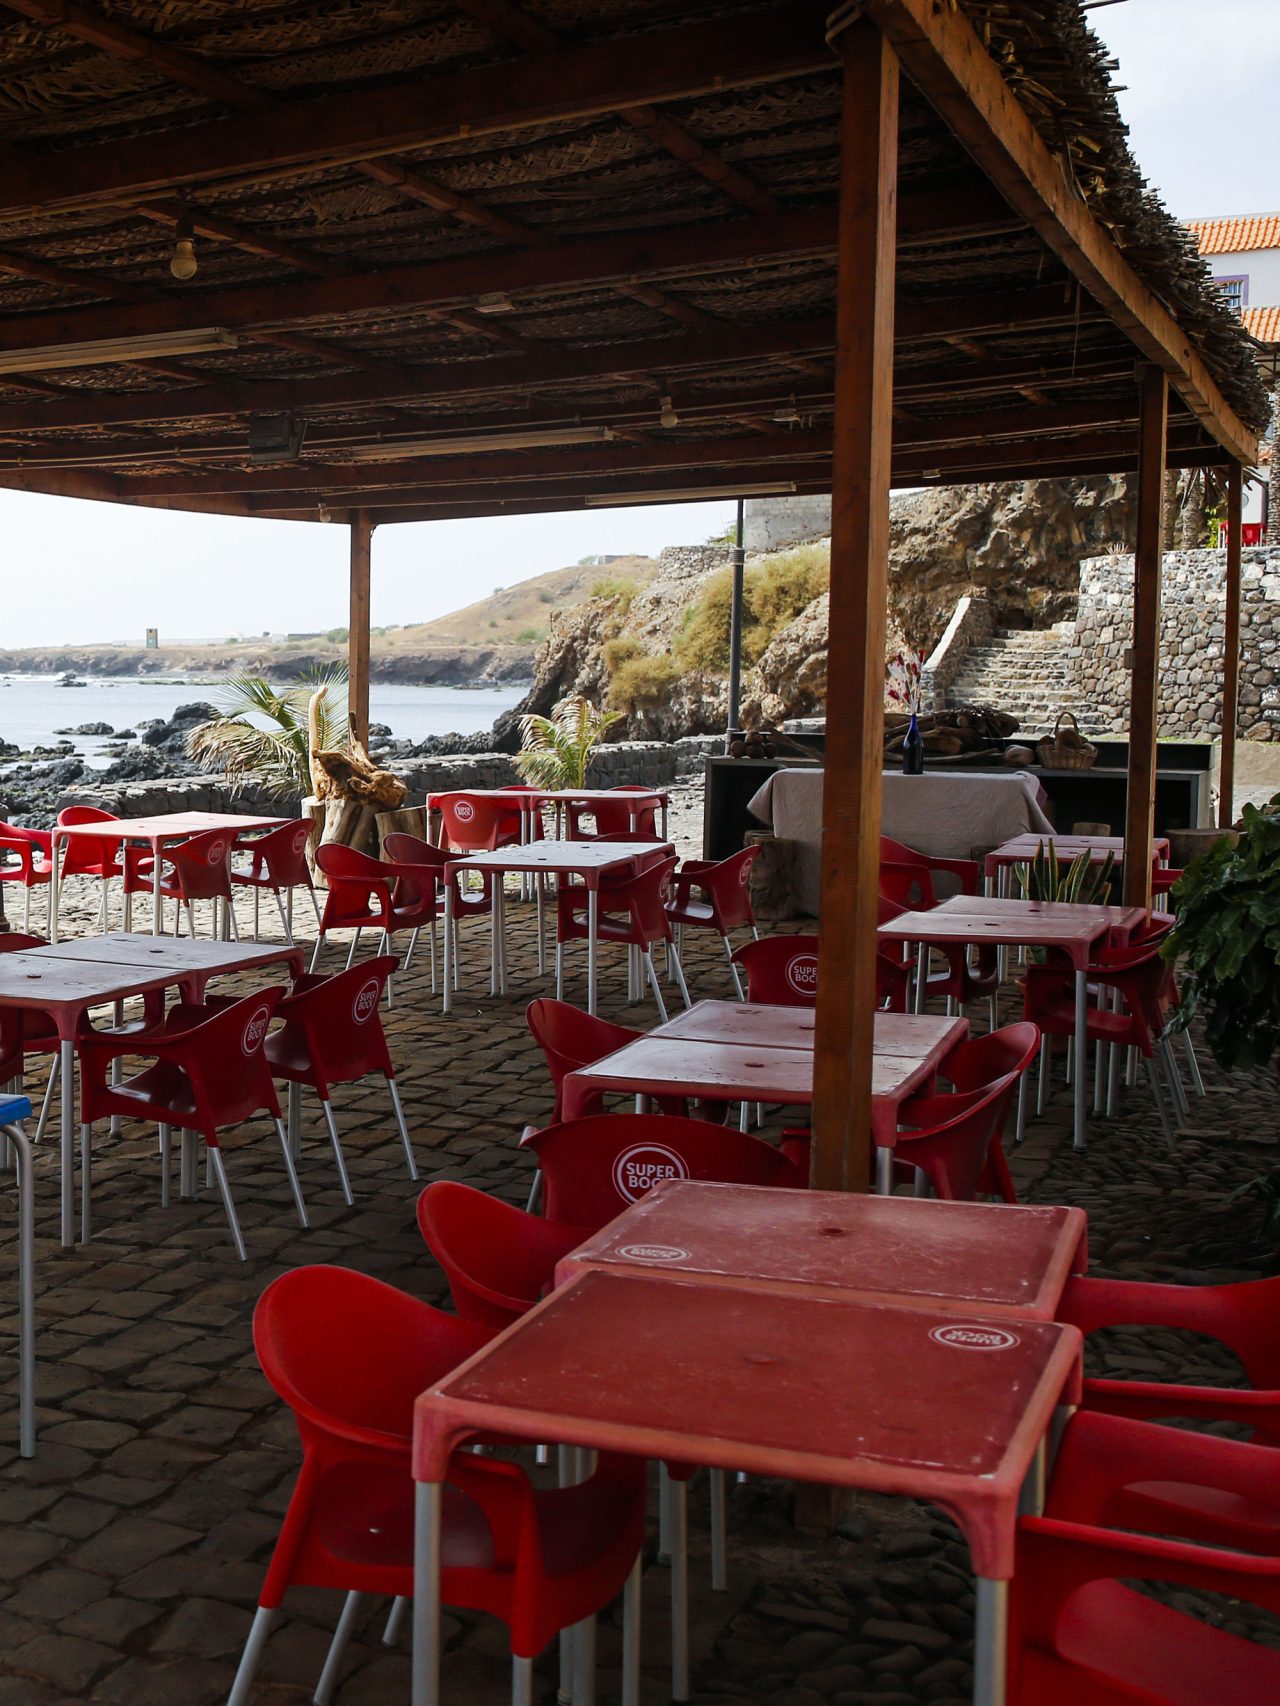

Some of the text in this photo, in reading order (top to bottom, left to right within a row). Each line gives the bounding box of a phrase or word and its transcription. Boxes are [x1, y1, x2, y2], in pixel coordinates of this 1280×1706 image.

[793, 965, 817, 975] SUPE
[795, 974, 817, 983] BOC
[359, 990, 376, 1001] SUPER
[358, 1000, 373, 1010] BOCK
[249, 1018, 267, 1031] SUPER
[248, 1029, 263, 1041] BOCK
[626, 1162, 675, 1178] SUPER
[628, 1175, 661, 1189] BOC
